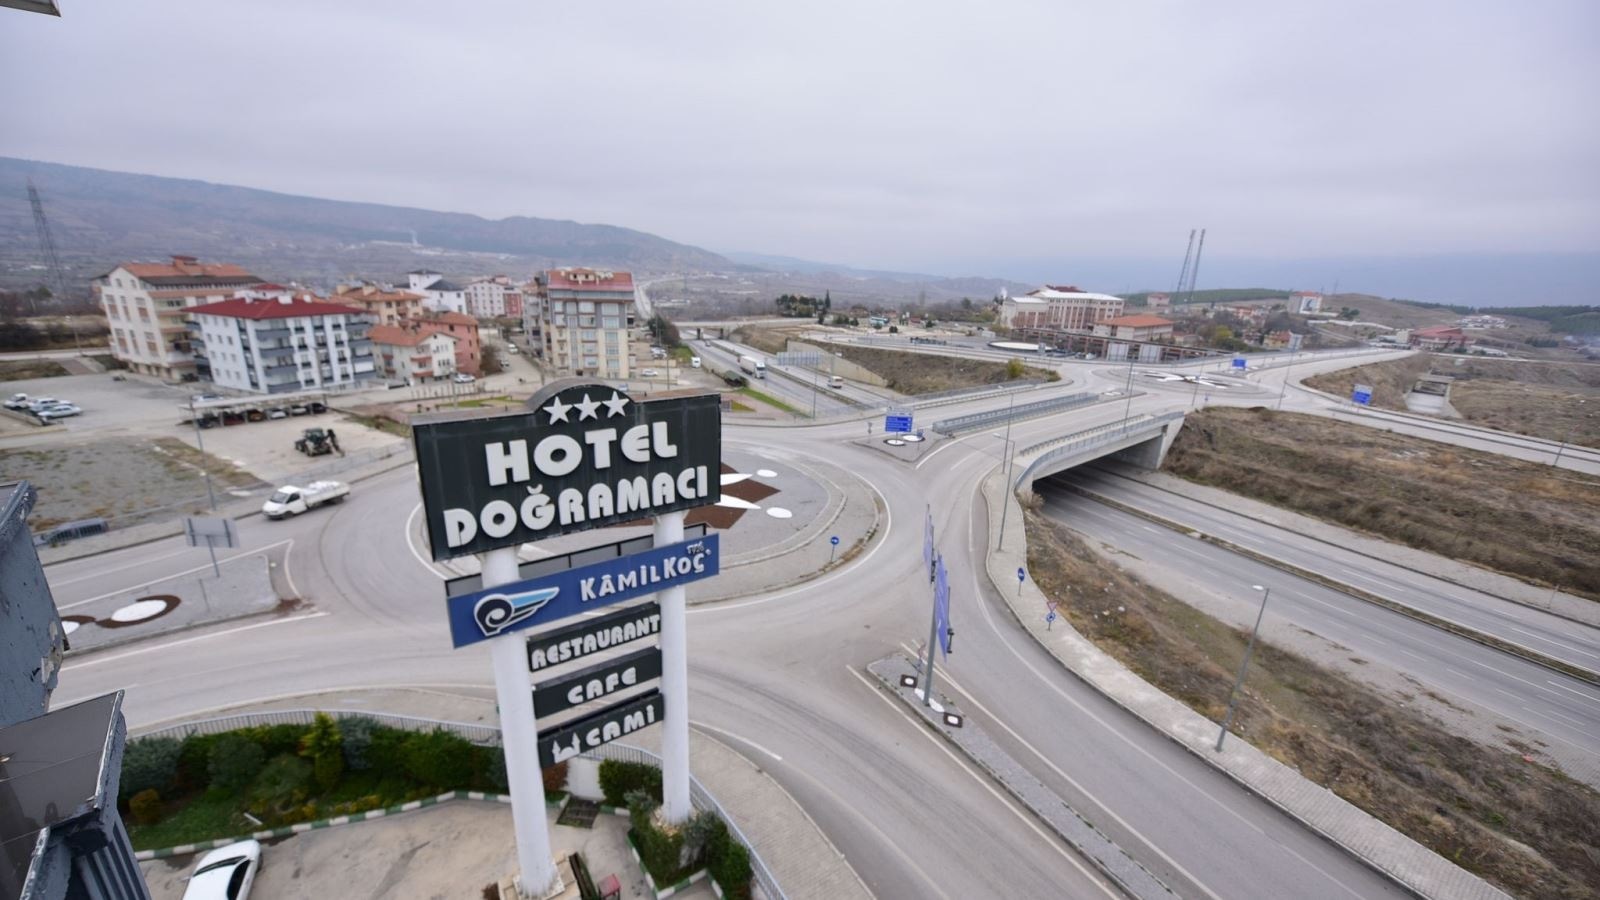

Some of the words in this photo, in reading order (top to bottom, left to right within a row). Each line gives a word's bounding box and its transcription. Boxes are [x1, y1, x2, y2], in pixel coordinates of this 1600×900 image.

[485, 421, 678, 487] HOTEL
[442, 464, 708, 548] DOĞRAMACI
[663, 552, 706, 579] KOÇ
[531, 614, 661, 671] RESTAURANT
[567, 666, 637, 704] CAFE
